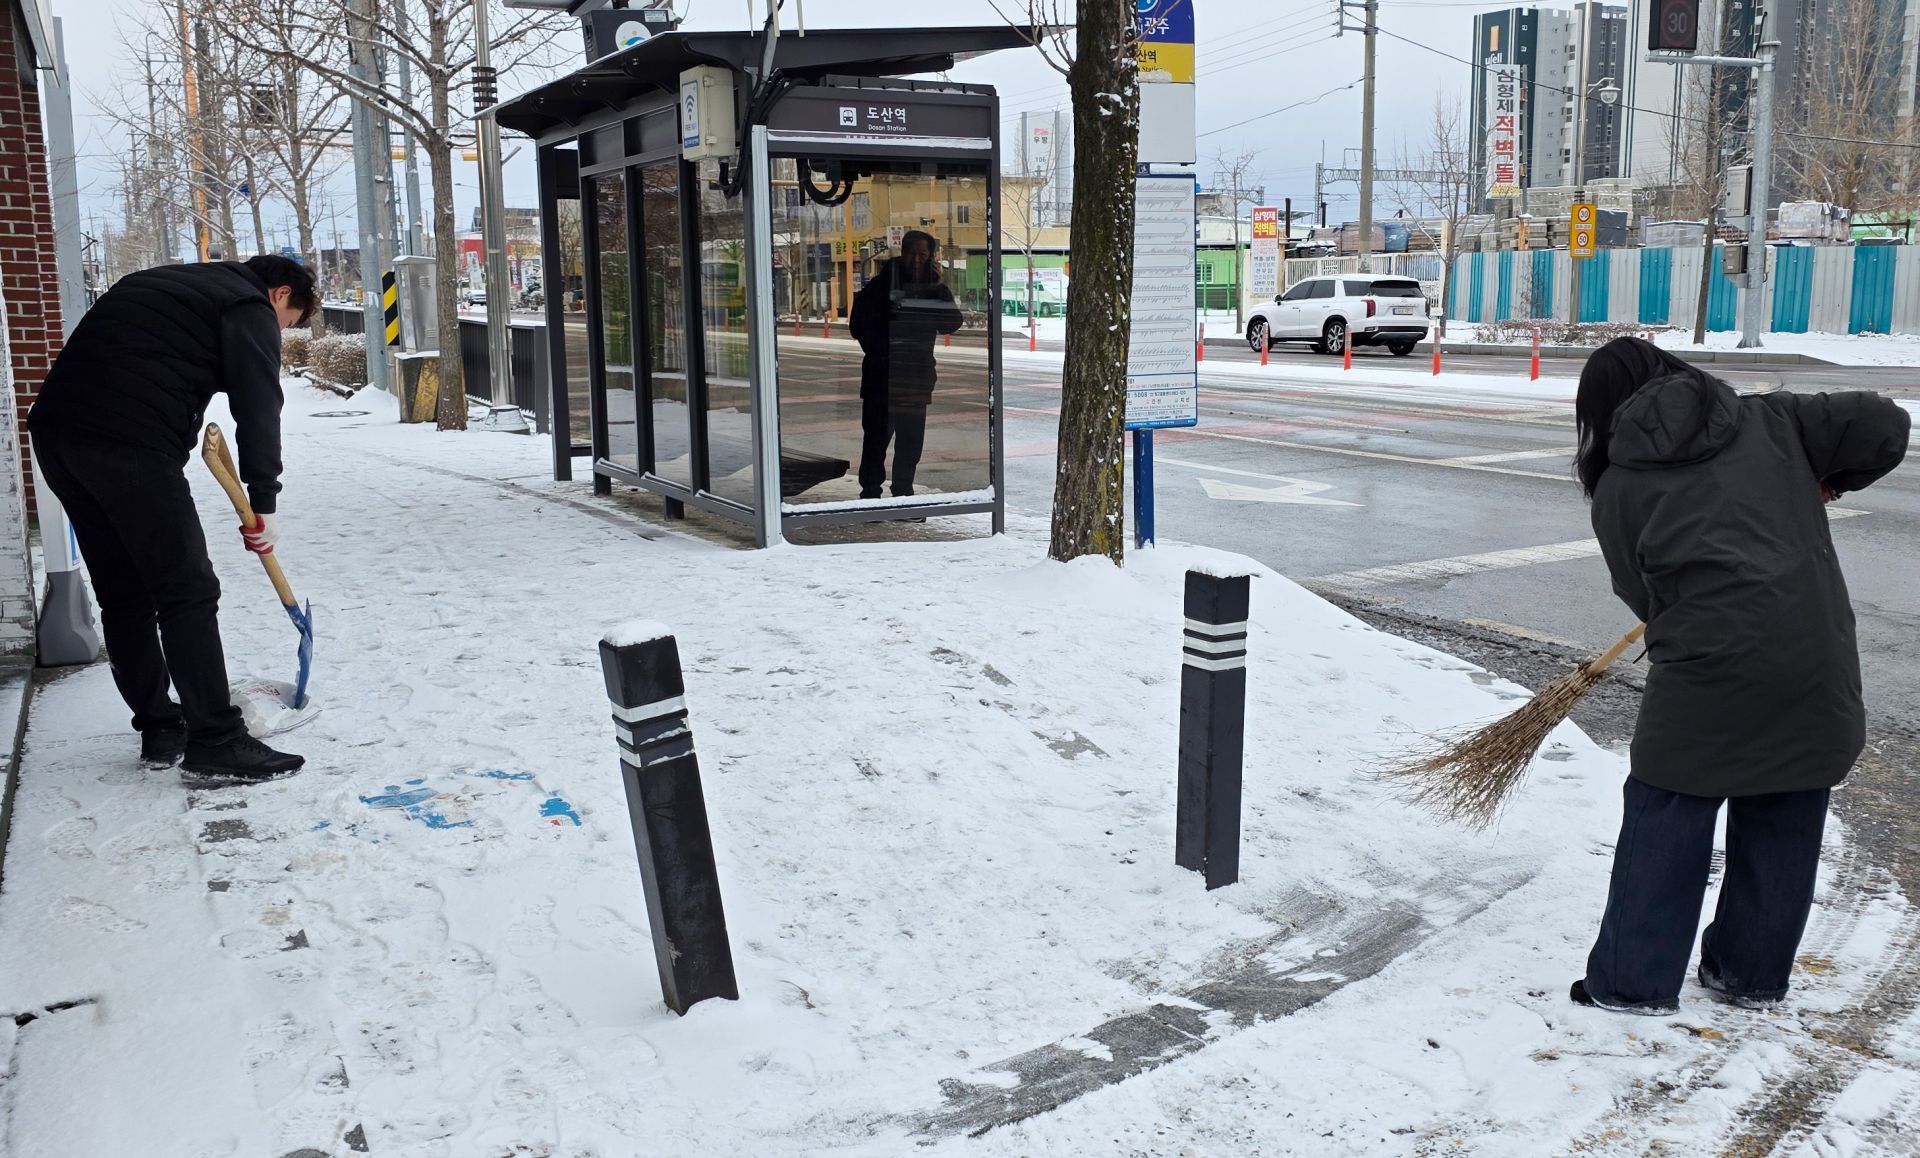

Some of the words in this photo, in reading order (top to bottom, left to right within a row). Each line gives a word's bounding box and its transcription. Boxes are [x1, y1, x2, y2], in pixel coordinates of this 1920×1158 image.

[1144, 17, 1170, 35] 광주
[1668, 12, 1687, 33] 30
[1137, 49, 1157, 63] 산역
[866, 106, 906, 124] 도산역
[868, 123, 886, 131] Dosan
[887, 124, 907, 132] Station
[1641, 190, 1657, 201] 203
[1580, 210, 1589, 219] 30
[1254, 221, 1277, 236] 적벽돌
[1579, 235, 1587, 244] 50
